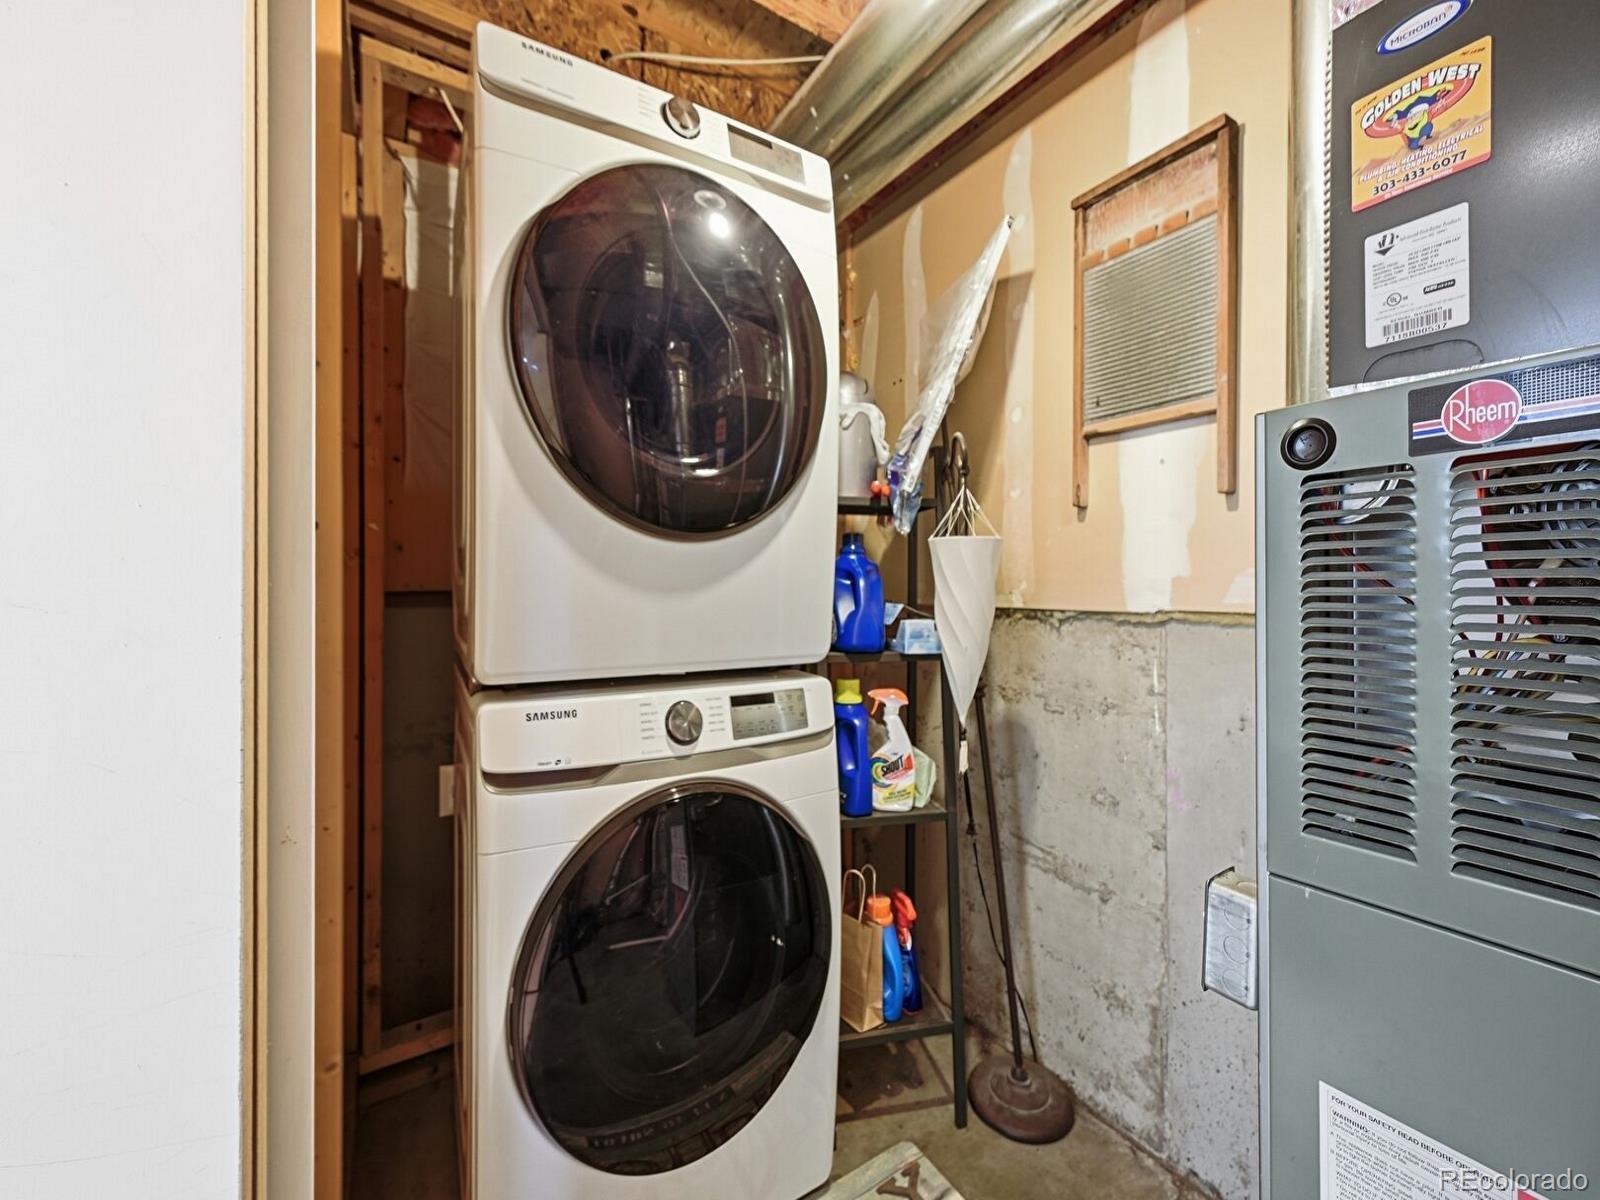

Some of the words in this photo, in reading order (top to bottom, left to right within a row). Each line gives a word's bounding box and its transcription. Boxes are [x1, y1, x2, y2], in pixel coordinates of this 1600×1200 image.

[520, 41, 574, 67] SAMSUNG
[1361, 76, 1423, 129] GOLDEN
[1427, 63, 1481, 88] WEST
[1373, 149, 1467, 196] 303-433-6077
[1449, 385, 1516, 432] Rheem
[526, 709, 578, 722] SAMSUNG
[1331, 1095, 1345, 1106] FOR
[1347, 1104, 1366, 1117] YOUR
[1368, 1115, 1395, 1132] SAFETY
[1398, 1130, 1418, 1145] READ
[1420, 1141, 1453, 1164] BEFORE
